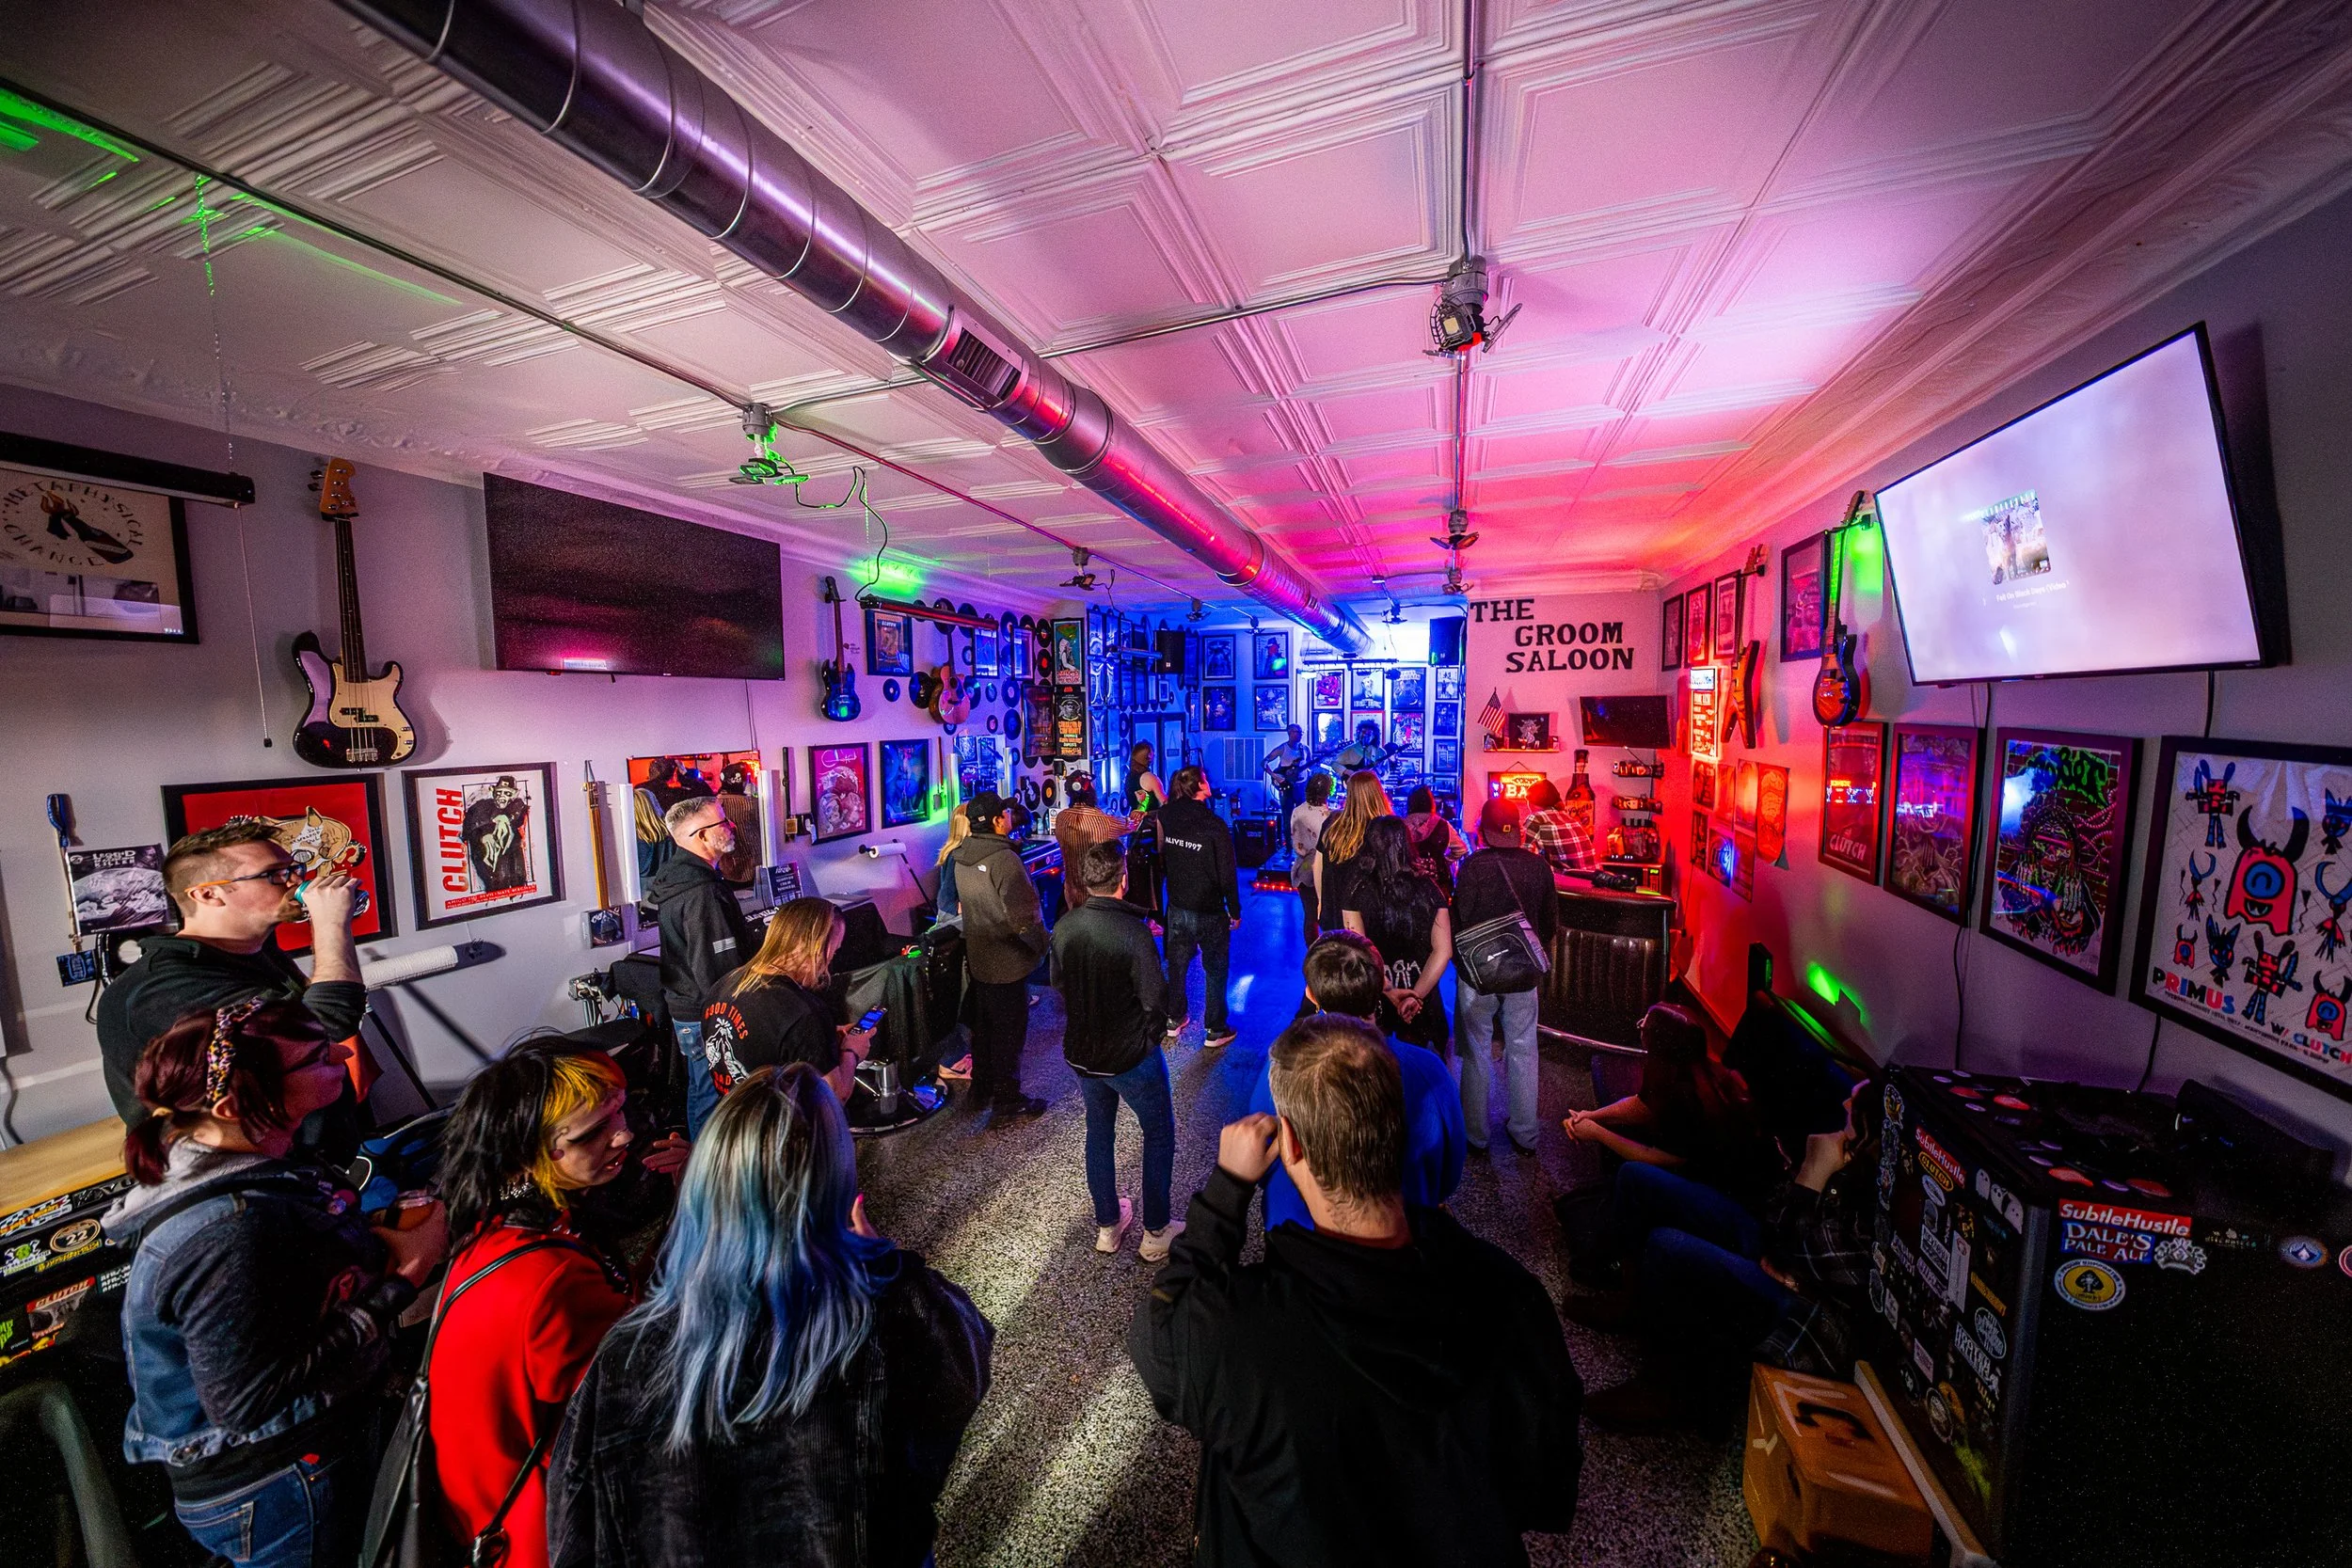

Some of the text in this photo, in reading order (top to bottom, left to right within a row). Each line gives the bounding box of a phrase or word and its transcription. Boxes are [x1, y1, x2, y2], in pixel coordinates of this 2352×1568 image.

[4, 523, 104, 567] CHANGE
[1470, 598, 1534, 623] THE
[1515, 622, 1624, 647] GROOM
[1505, 647, 1635, 673] SALOON
[436, 787, 469, 893] CLUTCH
[1185, 841, 1202, 852] 1997
[1829, 833, 1867, 861] CLUTCH
[2152, 965, 2235, 1016] PRIMUS
[704, 1002, 750, 1040] GOOD TIMES
[2292, 1032, 2352, 1065] CLUTCH
[713, 1071, 732, 1086] BAD
[1915, 1129, 1966, 1182] SubtleHustle
[1921, 1156, 1950, 1188] CLUTCH
[2060, 1203, 2190, 1236] SubtleHustle
[65, 1230, 89, 1246] 22
[2064, 1239, 2107, 1255] PALE
[2066, 1223, 2153, 1250] DALE'S
[35, 1279, 91, 1307] CLUTCH
